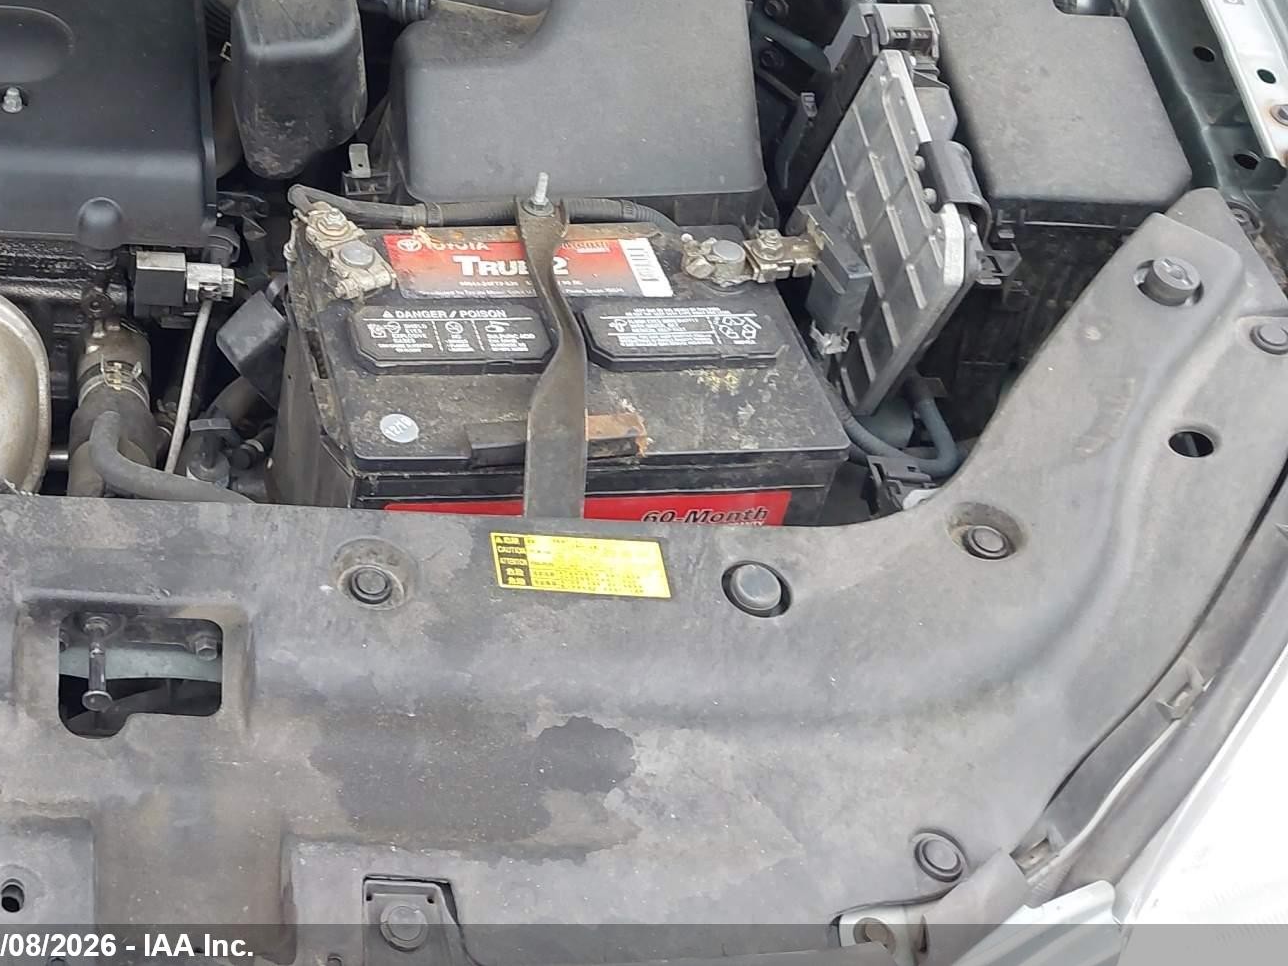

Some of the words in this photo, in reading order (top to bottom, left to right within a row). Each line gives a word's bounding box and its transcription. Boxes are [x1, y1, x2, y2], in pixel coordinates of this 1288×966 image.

[395, 310, 447, 318] DANGER
[459, 309, 507, 318] POISON
[641, 506, 770, 524] 60-Month
